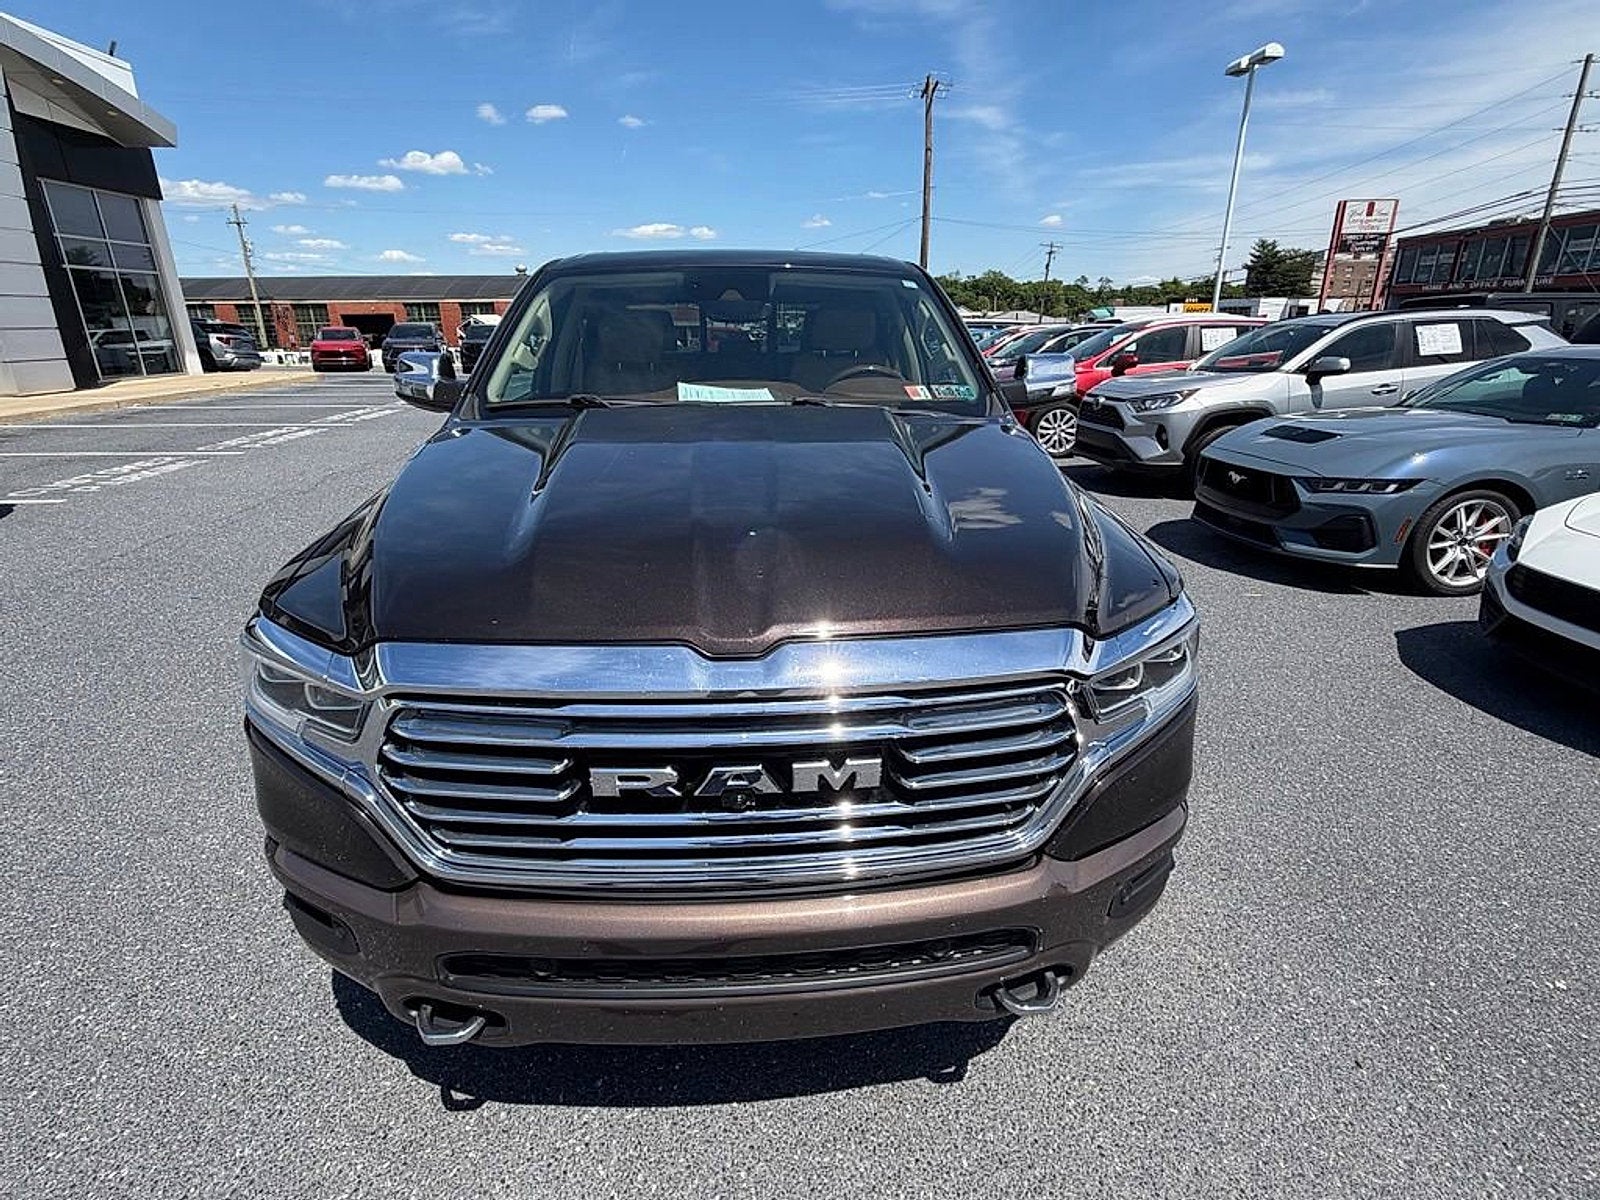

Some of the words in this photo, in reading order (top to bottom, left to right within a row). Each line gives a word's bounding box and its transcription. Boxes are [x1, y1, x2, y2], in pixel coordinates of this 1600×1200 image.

[1447, 281, 1465, 290] AND
[1502, 276, 1553, 288] FURNTURE
[589, 758, 882, 797] RAM
